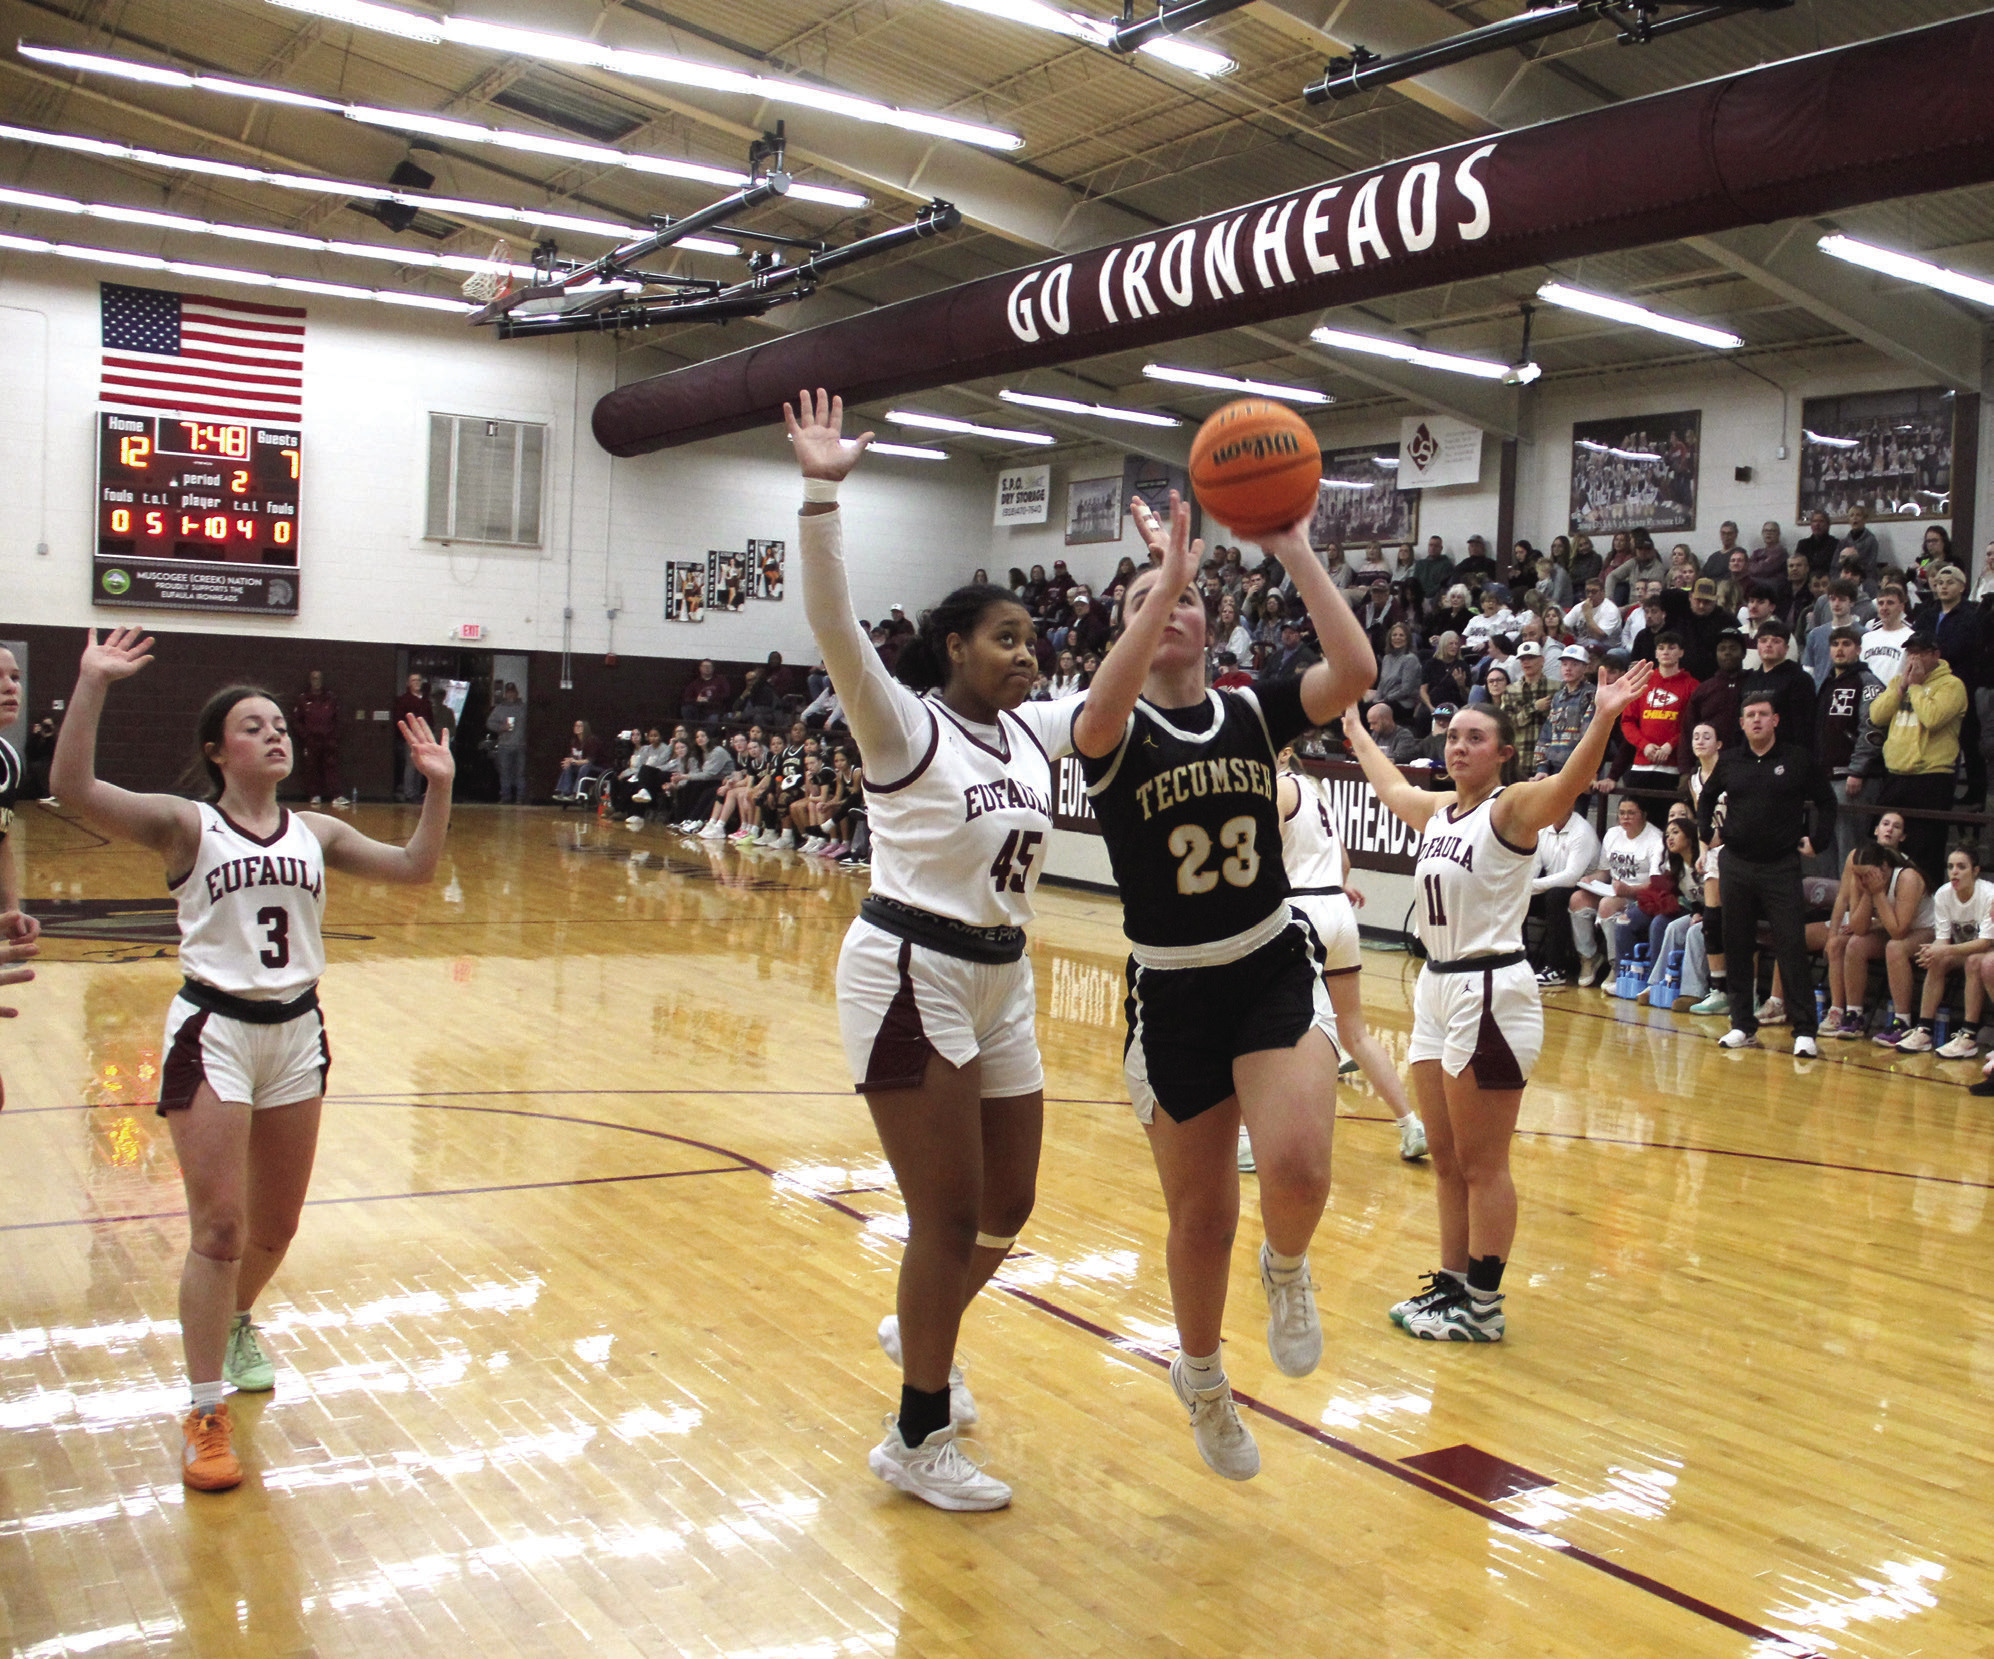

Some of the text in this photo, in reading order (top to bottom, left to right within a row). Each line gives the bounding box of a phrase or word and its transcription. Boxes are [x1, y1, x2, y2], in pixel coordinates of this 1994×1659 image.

[1007, 143, 1499, 343] GO IRONHEADS
[108, 415, 144, 433] Home
[179, 421, 246, 457] 7:48
[257, 430, 298, 447] Guests
[120, 435, 150, 468] 12
[280, 449, 299, 480] 7
[183, 469, 248, 493] period 2
[103, 487, 133, 503] fouls
[181, 493, 221, 510] player
[1001, 489, 1045, 505] DRY STORAGE
[266, 501, 295, 515] fouls
[111, 508, 130, 532] 0
[146, 511, 163, 535] 5
[236, 519, 253, 540] 4
[273, 520, 291, 544] 0
[136, 571, 263, 587] MUSCOGEE (CREEK) NATION
[155, 582, 244, 595] PROUDLY SUPPORTS THE
[161, 591, 238, 602] EUFAULA IRONHEADS
[463, 624, 480, 637] EXIT
[1864, 646, 1902, 661] COMMUNITY
[1642, 709, 1679, 721] CHIEFS
[990, 828, 1043, 894] 45
[1168, 814, 1261, 896] 23
[1424, 873, 1448, 926] 11
[257, 906, 289, 969] 3
